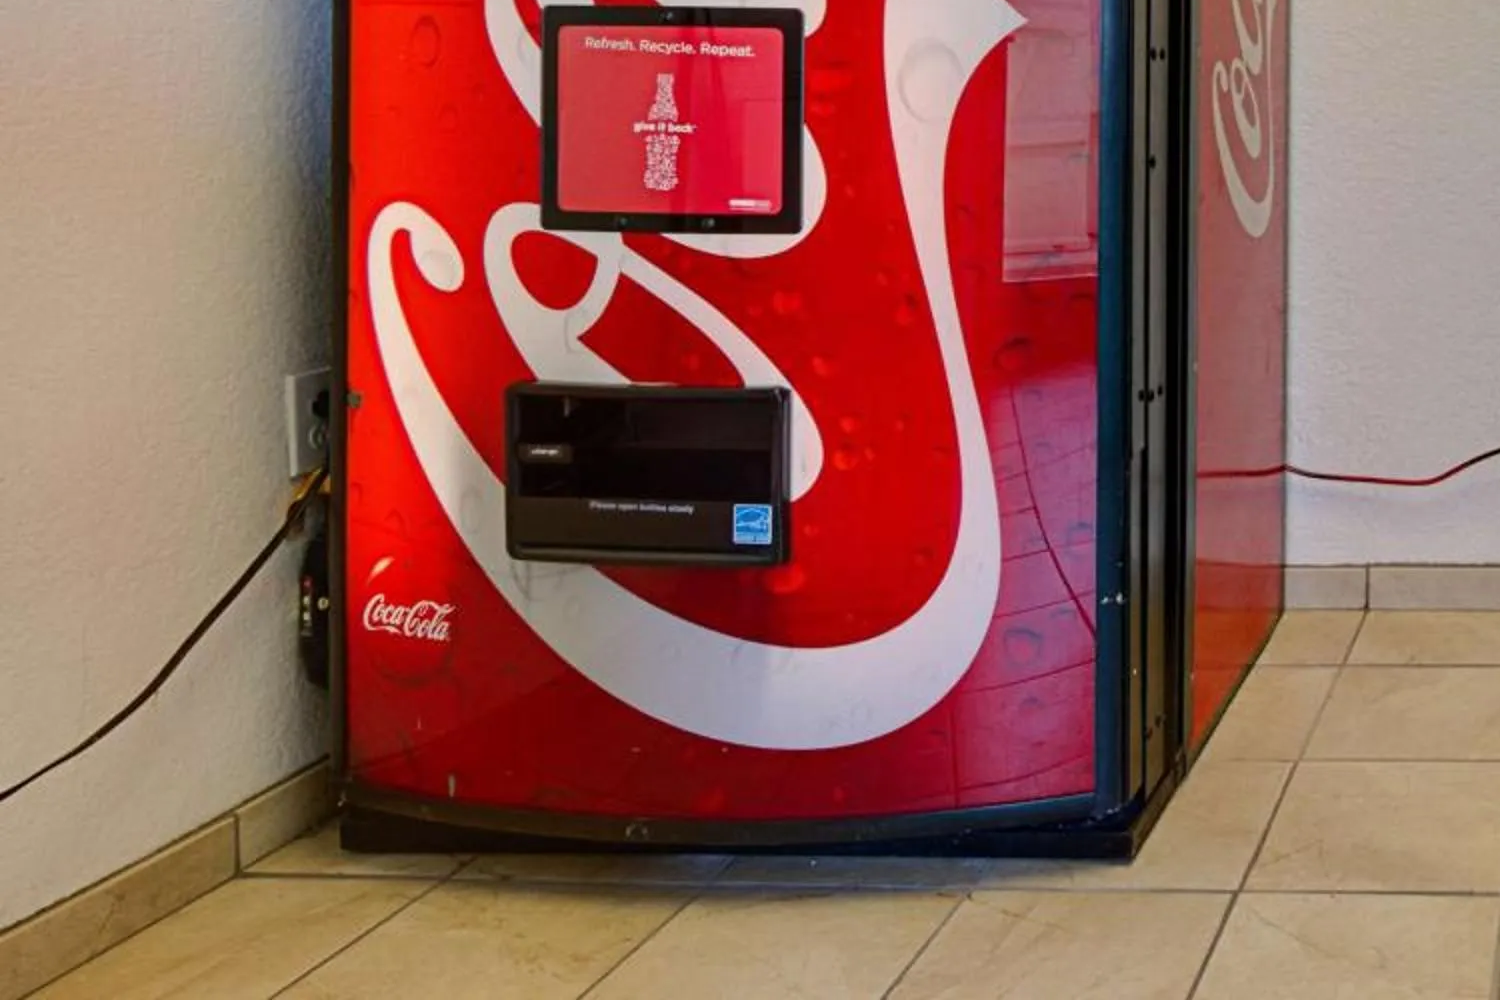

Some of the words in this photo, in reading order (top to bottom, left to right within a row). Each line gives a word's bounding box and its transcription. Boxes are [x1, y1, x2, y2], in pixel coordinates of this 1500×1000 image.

[585, 36, 635, 50] Refresh.
[639, 39, 697, 55] Recycle.
[700, 41, 756, 57] Repeat.
[363, 593, 456, 641] Coca-Cola
